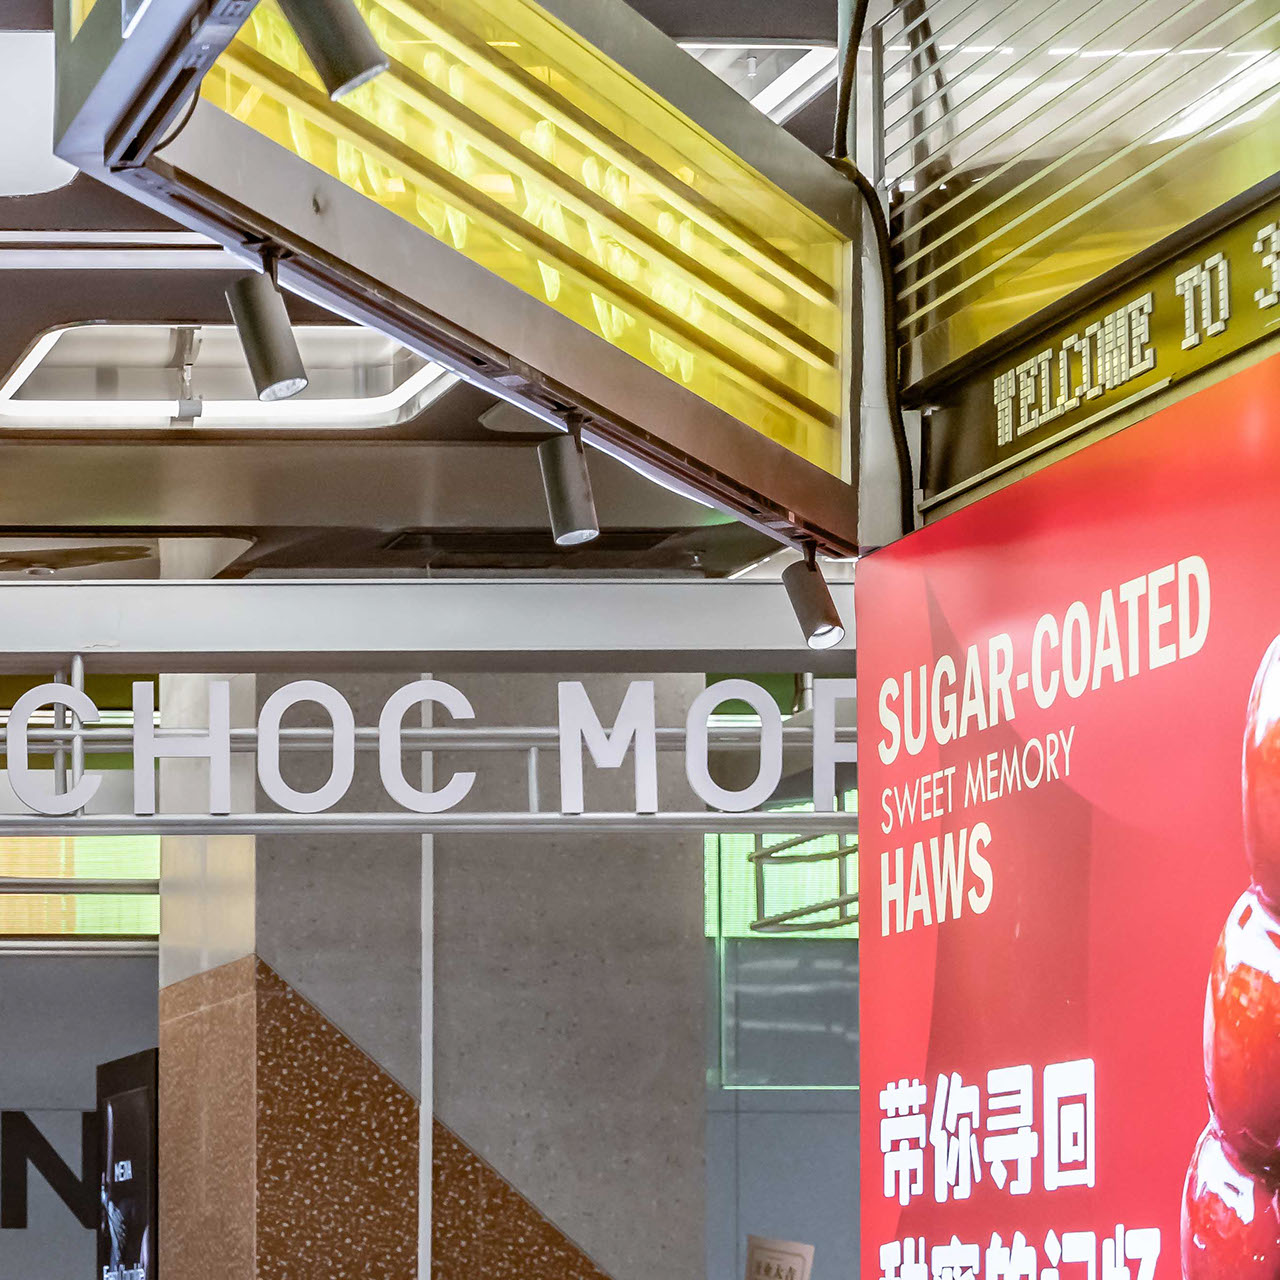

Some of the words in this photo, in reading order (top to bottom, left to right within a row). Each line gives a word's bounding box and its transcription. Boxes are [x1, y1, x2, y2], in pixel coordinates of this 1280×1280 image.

[993, 291, 1158, 448] WELCOME
[1175, 251, 1231, 351] TO
[877, 555, 1211, 766] SUGAR-COATED
[6, 679, 477, 815] CHOC
[880, 765, 956, 835] SWEET
[964, 724, 1076, 810] MEMORY
[880, 821, 994, 937] HAWS
[878, 1057, 1096, 1206] 带你寻回
